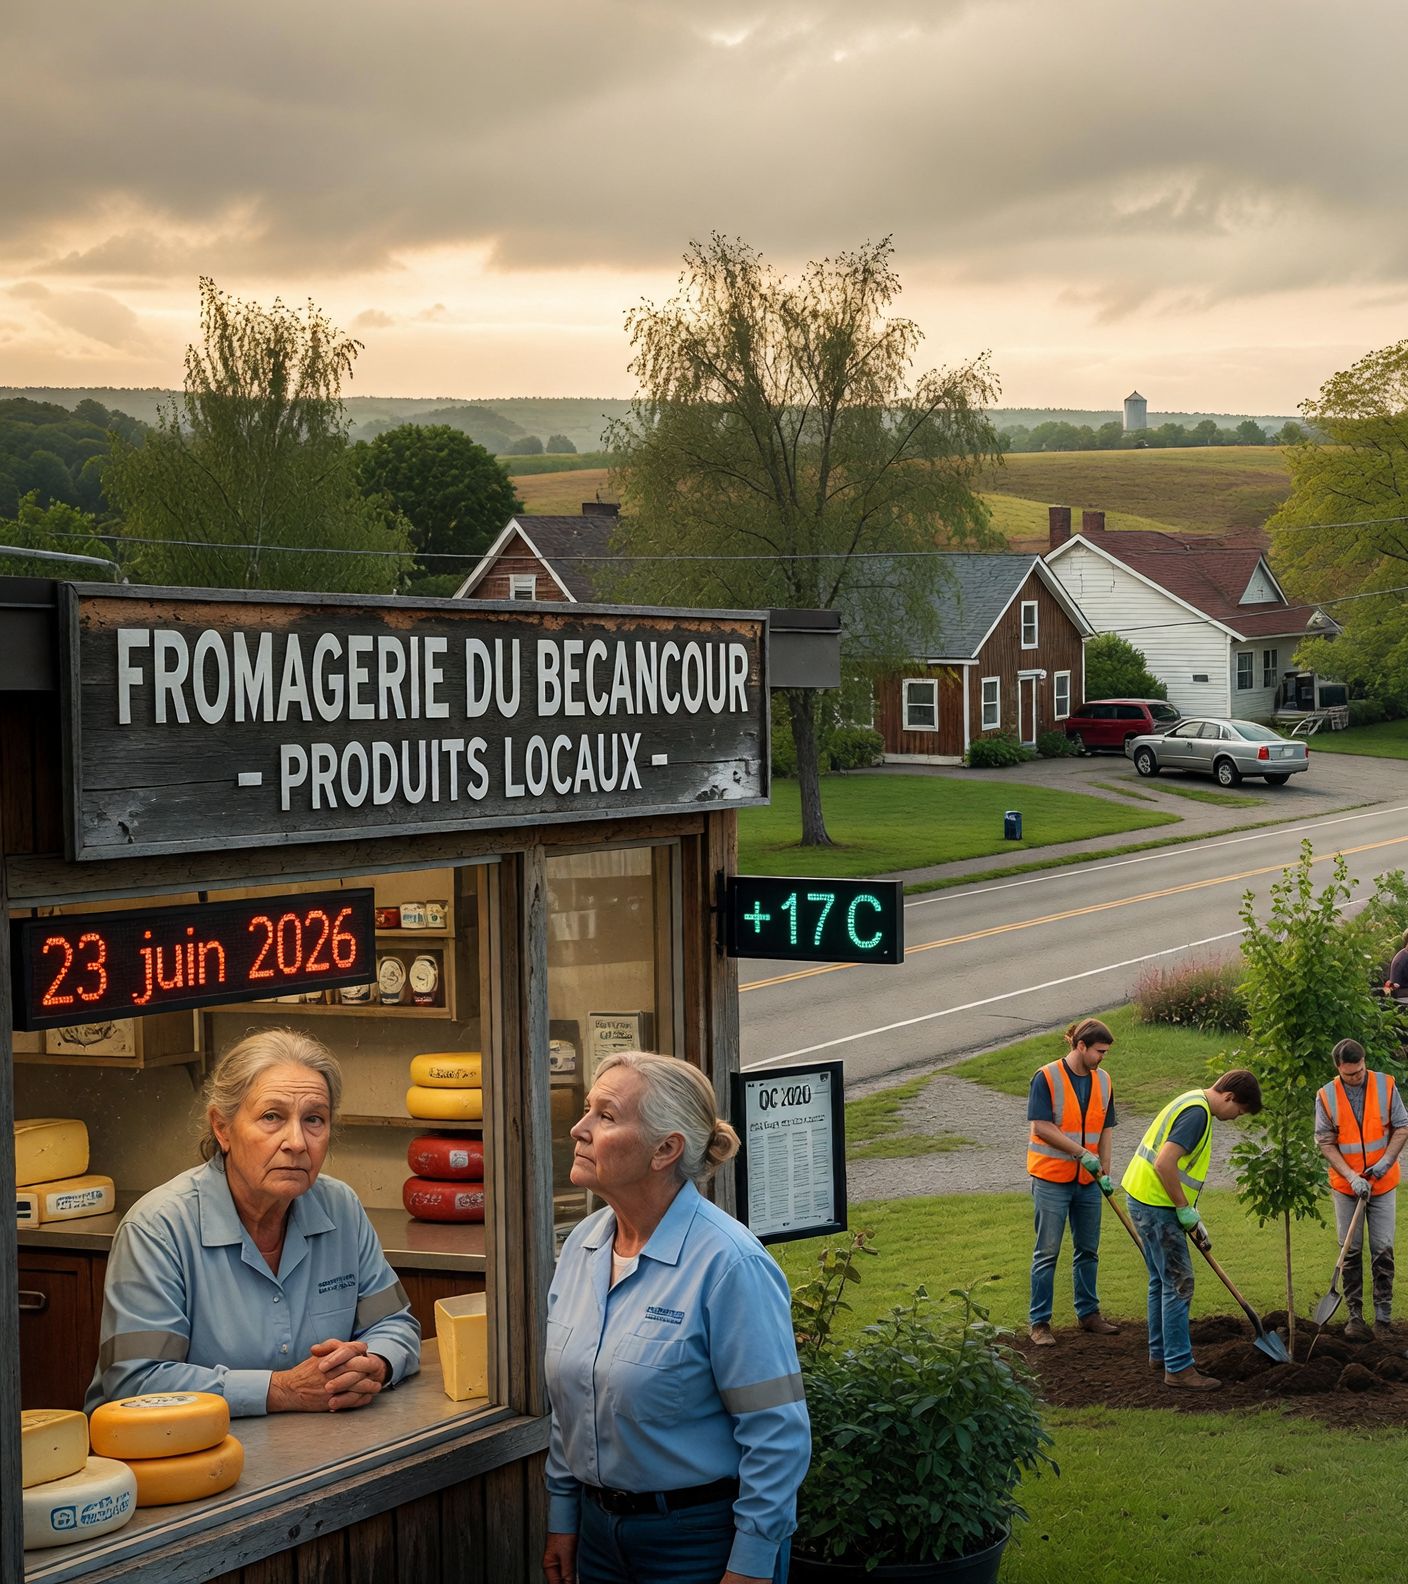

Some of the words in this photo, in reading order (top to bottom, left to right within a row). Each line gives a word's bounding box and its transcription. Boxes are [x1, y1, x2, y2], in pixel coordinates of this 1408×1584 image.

[117, 628, 450, 725] FROMAGERIE
[465, 638, 521, 718] DU
[537, 639, 749, 717] BECANCOUR
[280, 736, 489, 811] PRODUITS
[504, 733, 643, 798] LOCAUX
[42, 933, 108, 1006] 23
[131, 927, 226, 1006] juin
[248, 907, 357, 980] 2026
